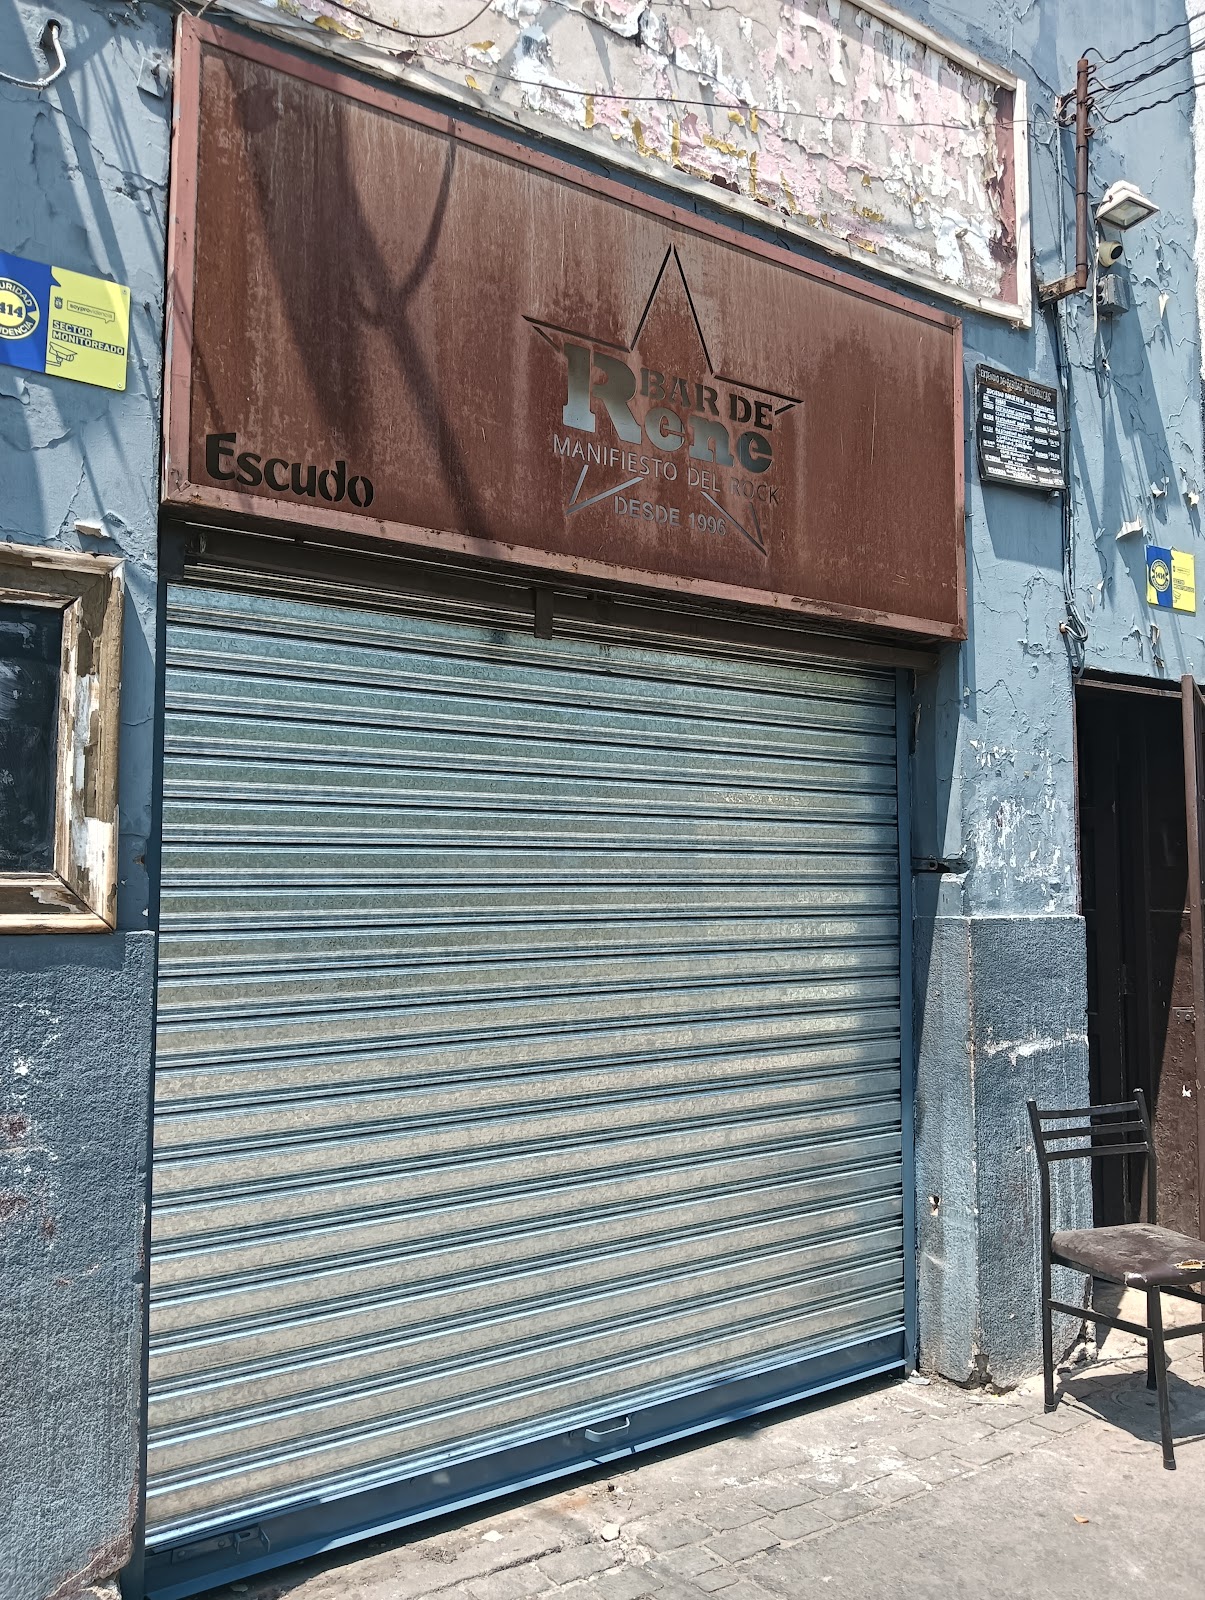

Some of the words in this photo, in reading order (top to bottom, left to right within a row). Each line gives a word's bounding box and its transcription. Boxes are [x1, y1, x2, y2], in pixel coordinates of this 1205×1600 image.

[52, 331, 125, 355] MONITOREADO
[53, 321, 92, 337] SECTOR
[562, 343, 773, 474] Rene
[640, 367, 719, 416] BAR
[729, 393, 772, 431] DE
[205, 432, 374, 508] Escudo
[553, 433, 678, 482] MANIFIESTO
[687, 467, 721, 493] DEL
[730, 477, 780, 506] ROCK
[613, 495, 680, 528] DESDE
[688, 512, 727, 537] 1996
